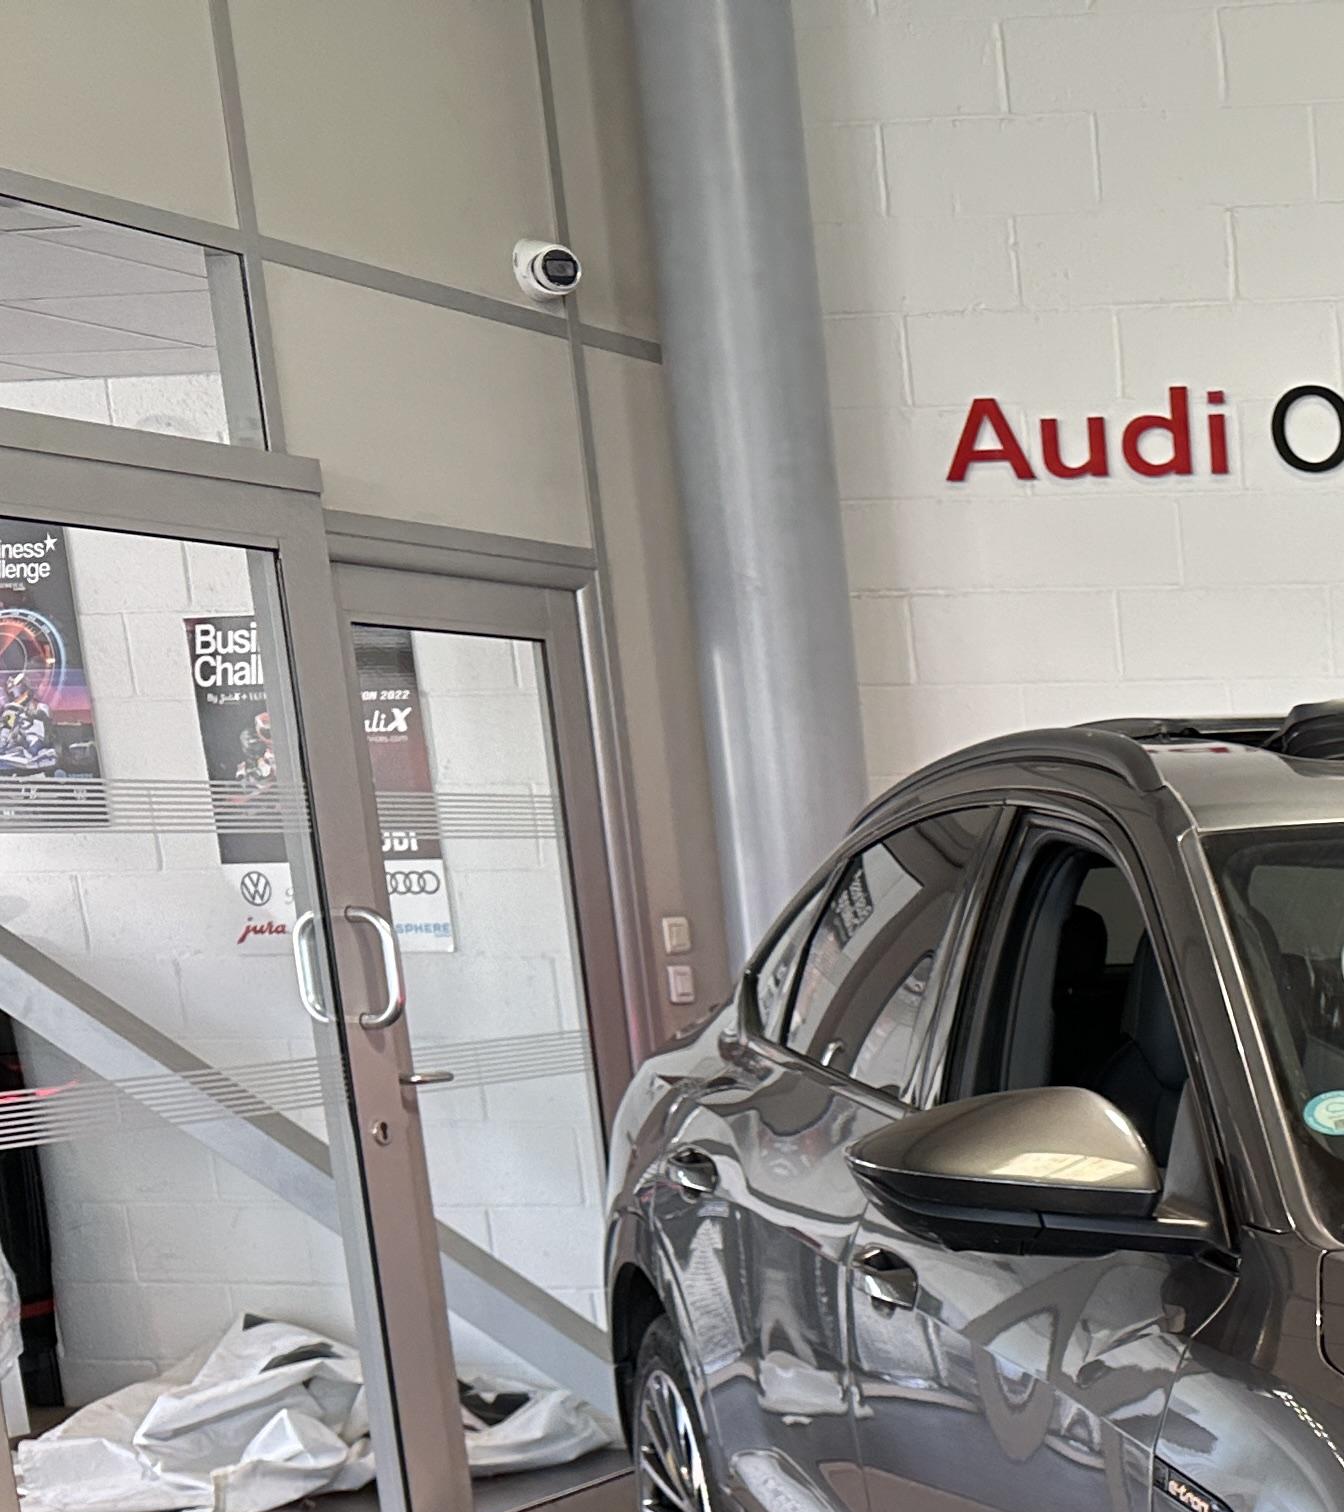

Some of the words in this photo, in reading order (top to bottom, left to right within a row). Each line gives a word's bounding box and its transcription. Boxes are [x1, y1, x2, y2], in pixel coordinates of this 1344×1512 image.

[946, 386, 1229, 482] Audi
[0, 560, 51, 584] lenge
[379, 689, 410, 700] 2022
[236, 917, 289, 945] jura
